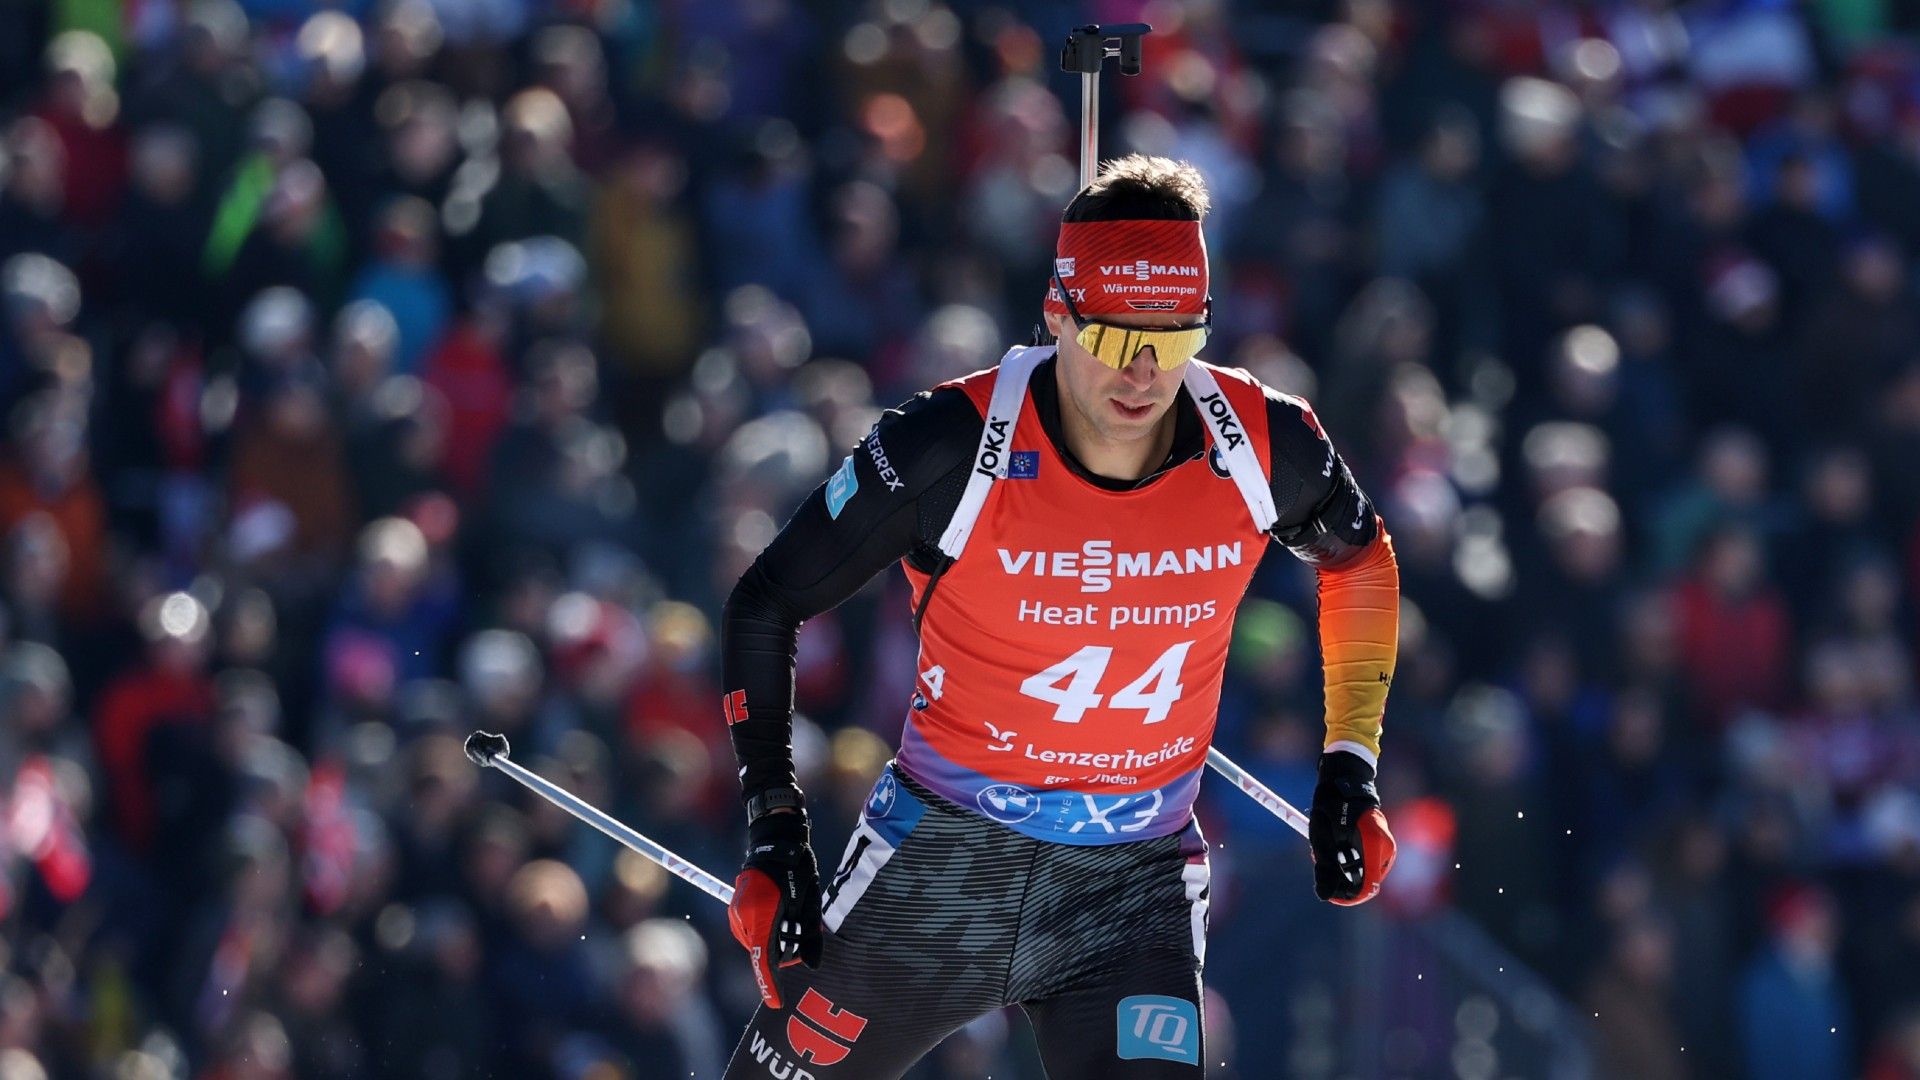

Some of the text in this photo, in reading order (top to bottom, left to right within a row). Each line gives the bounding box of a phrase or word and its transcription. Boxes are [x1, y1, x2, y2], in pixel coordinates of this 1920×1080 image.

[1100, 260, 1199, 281] VIESSMANN
[1103, 284, 1197, 296] Wärmepumpen
[1200, 392, 1240, 452] JOKA
[866, 424, 905, 493] TERREX
[976, 419, 1010, 481] JOKA
[997, 540, 1242, 593] VIESSMANN
[1018, 599, 1217, 630] Heat pumps
[1018, 639, 1197, 726] 44
[1024, 736, 1196, 770] Lenzerheide
[1068, 789, 1164, 834] X3
[1130, 1004, 1188, 1055] TQ
